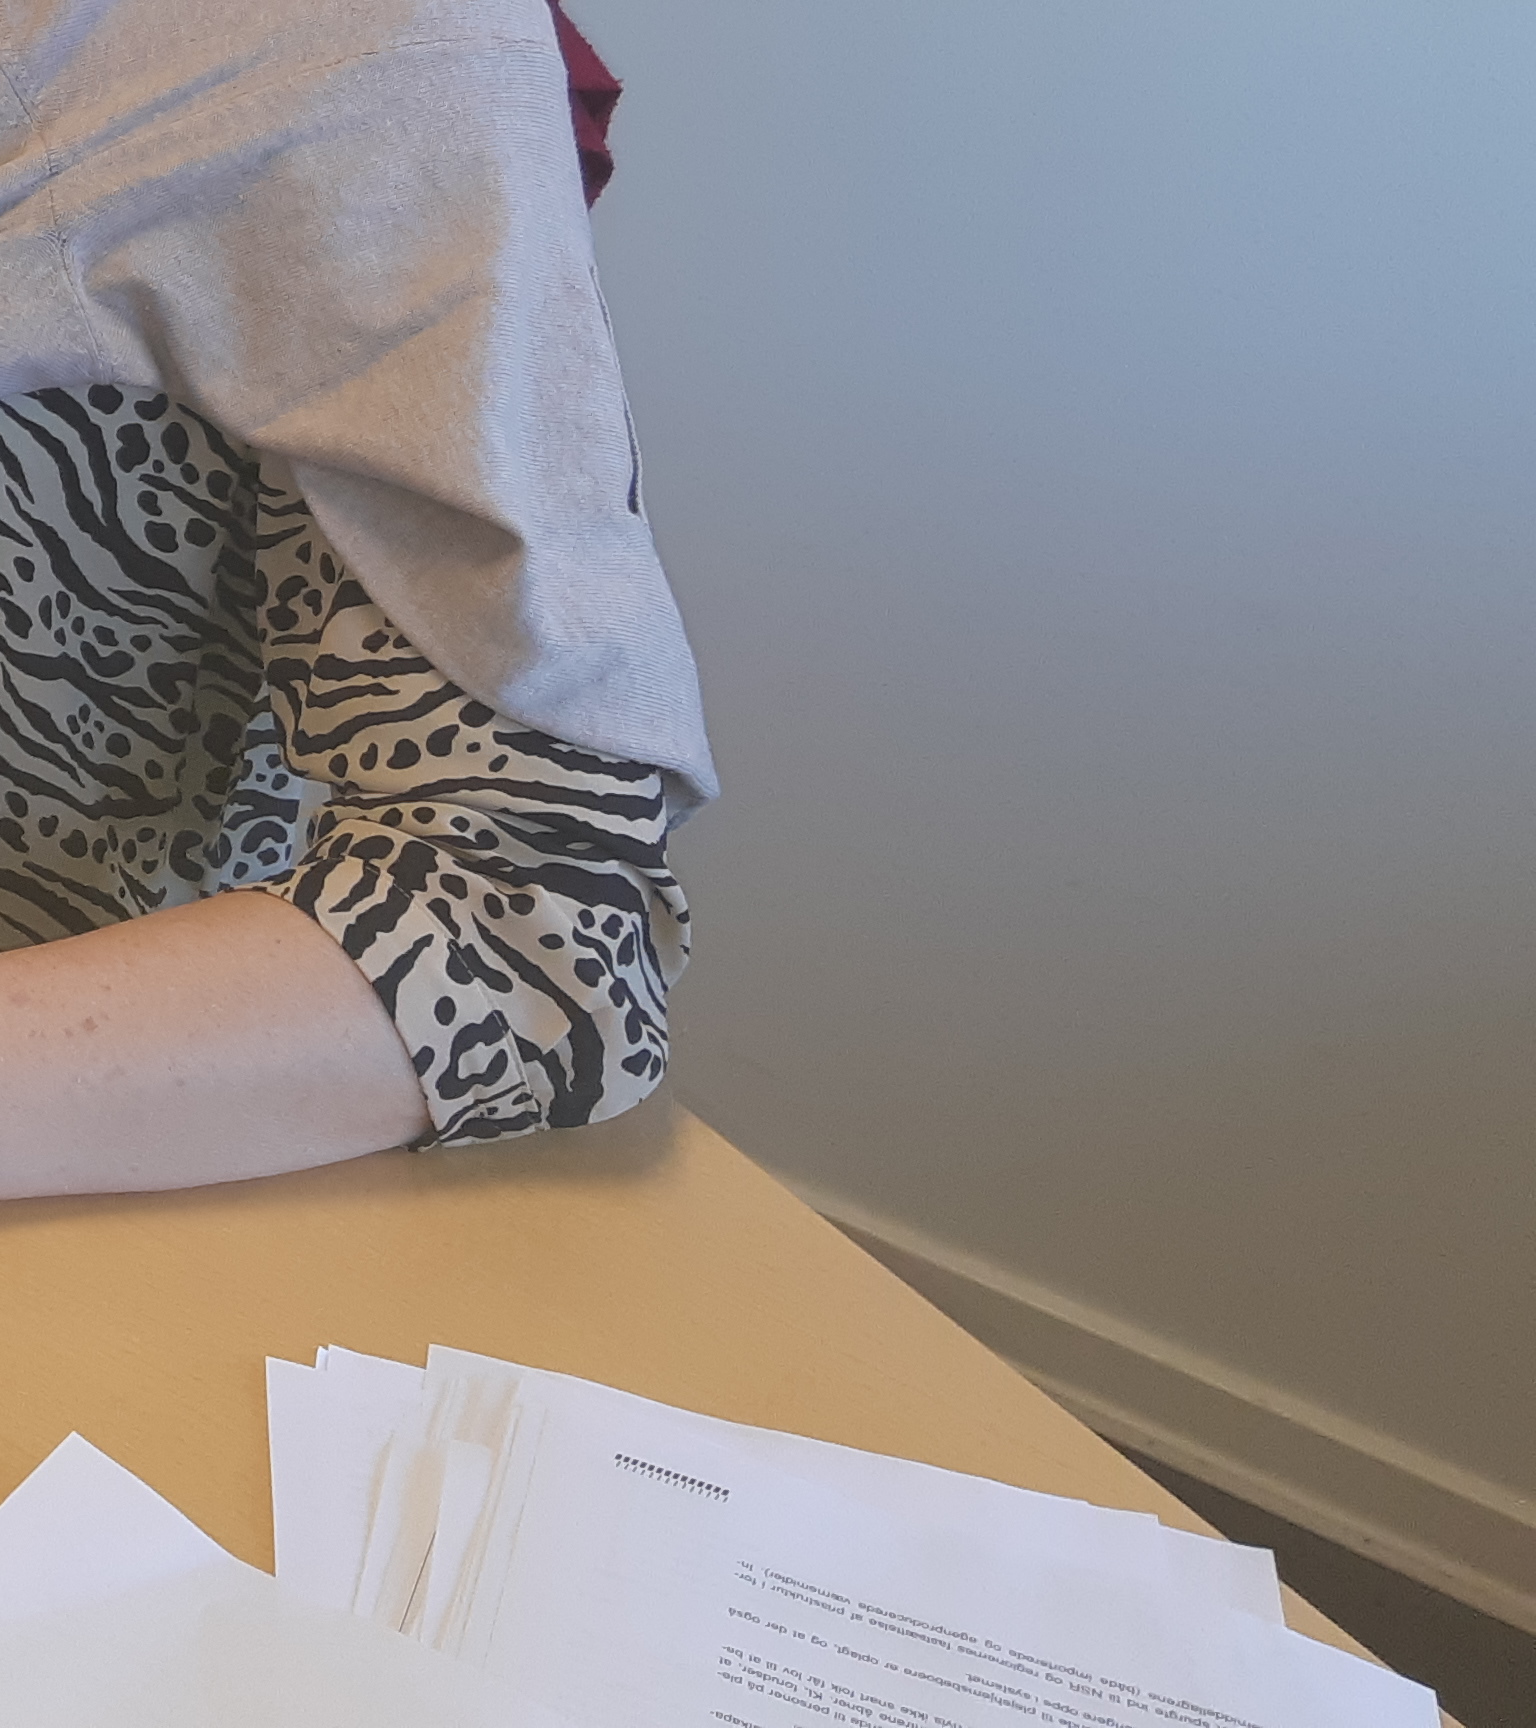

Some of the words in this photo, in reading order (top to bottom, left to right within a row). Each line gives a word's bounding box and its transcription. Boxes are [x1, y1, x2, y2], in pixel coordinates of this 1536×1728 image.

[728, 1607, 761, 1624] også
[858, 1602, 978, 1643] egenproducerede
[765, 1621, 787, 1635] der
[792, 1630, 806, 1640] at
[810, 1635, 828, 1648] og
[984, 1639, 1002, 1652] og
[718, 1656, 732, 1667] at
[748, 1654, 762, 1664] at
[766, 1661, 777, 1672] til
[957, 1645, 1039, 1678] regionernes
[1008, 1649, 1093, 1683] importerede
[782, 1666, 803, 1681] lov
[884, 1662, 899, 1672] er
[807, 1675, 826, 1689] får
[1045, 1672, 1063, 1684] og
[747, 1679, 765, 1694] på
[831, 1682, 855, 1699] folk
[903, 1667, 1037, 1715] plejehjemsbeboere
[768, 1688, 830, 1716] personer
[859, 1692, 895, 1710] snart
[900, 1705, 929, 1722] ikke
